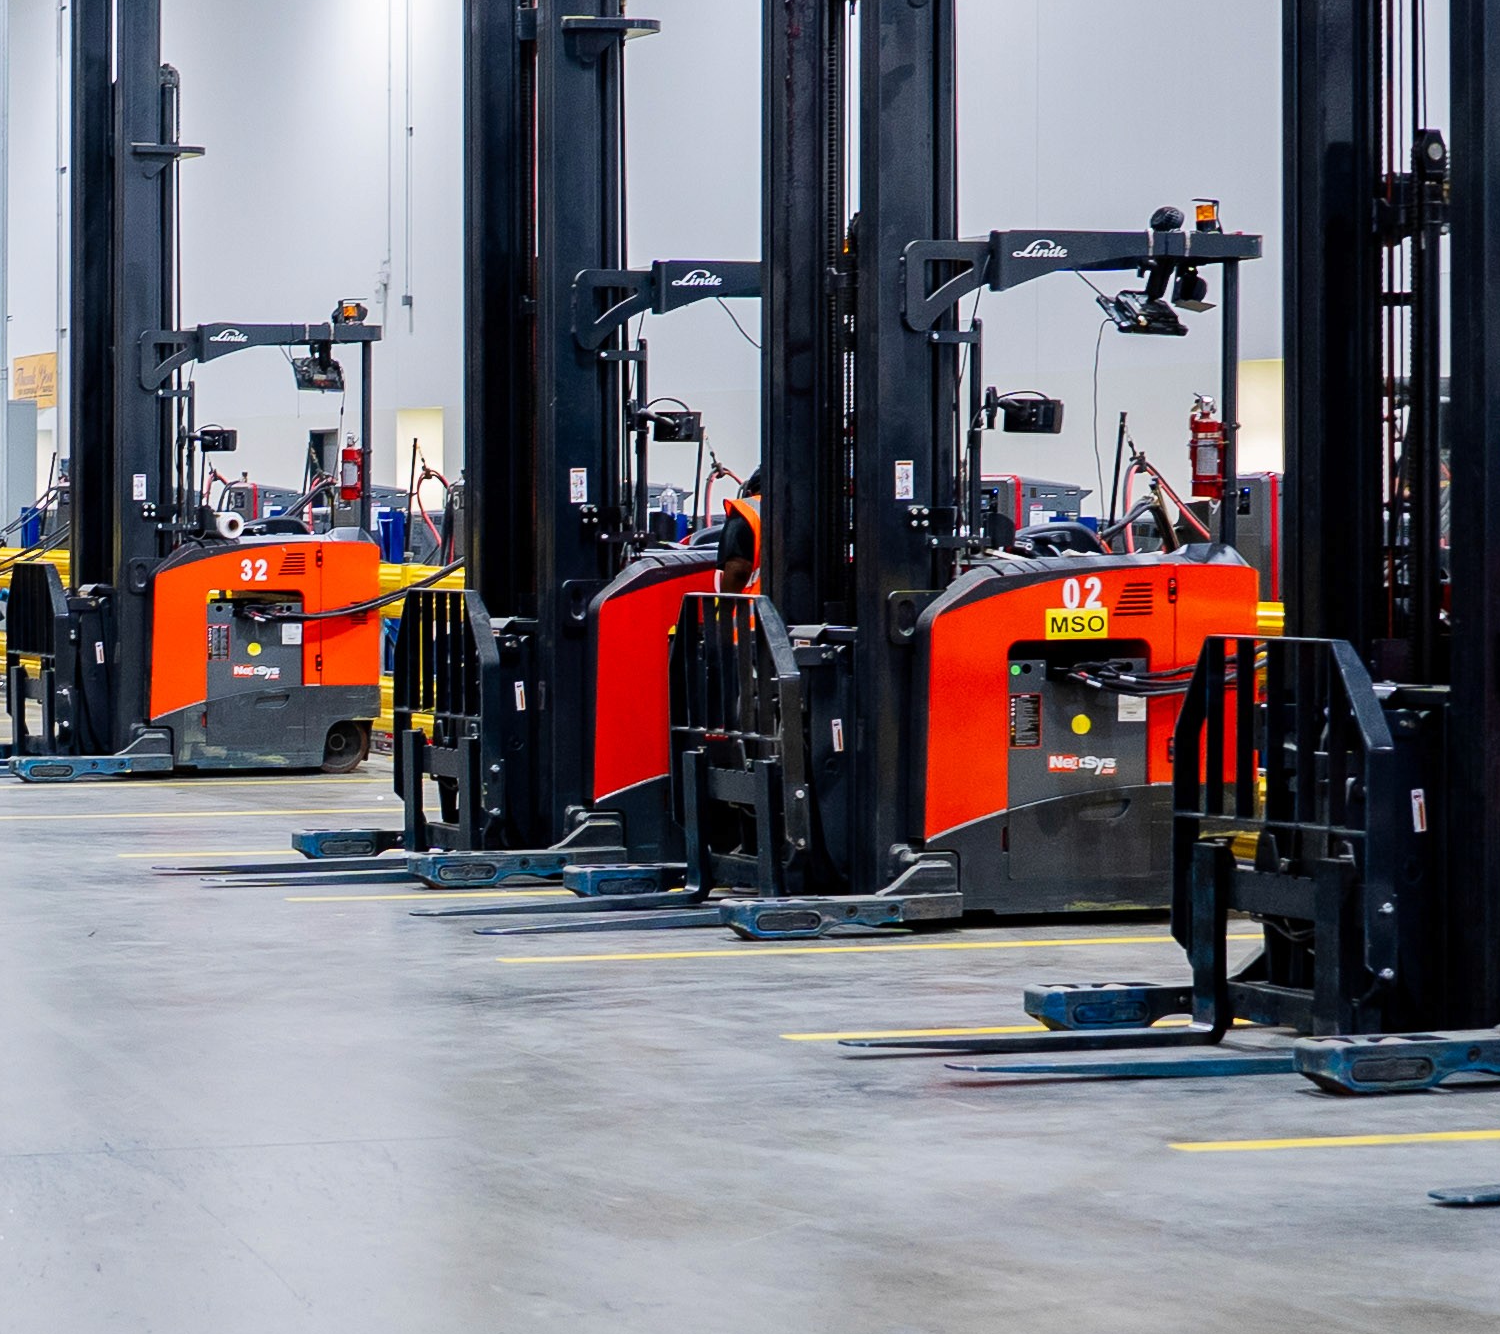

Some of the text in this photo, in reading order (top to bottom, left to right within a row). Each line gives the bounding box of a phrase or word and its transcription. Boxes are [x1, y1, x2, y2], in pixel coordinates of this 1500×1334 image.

[1012, 239, 1068, 258] Linde
[671, 269, 723, 287] Linde
[209, 328, 249, 342] Linde
[240, 558, 268, 581] 32
[1062, 576, 1103, 609] 02
[1050, 616, 1105, 633] MSO
